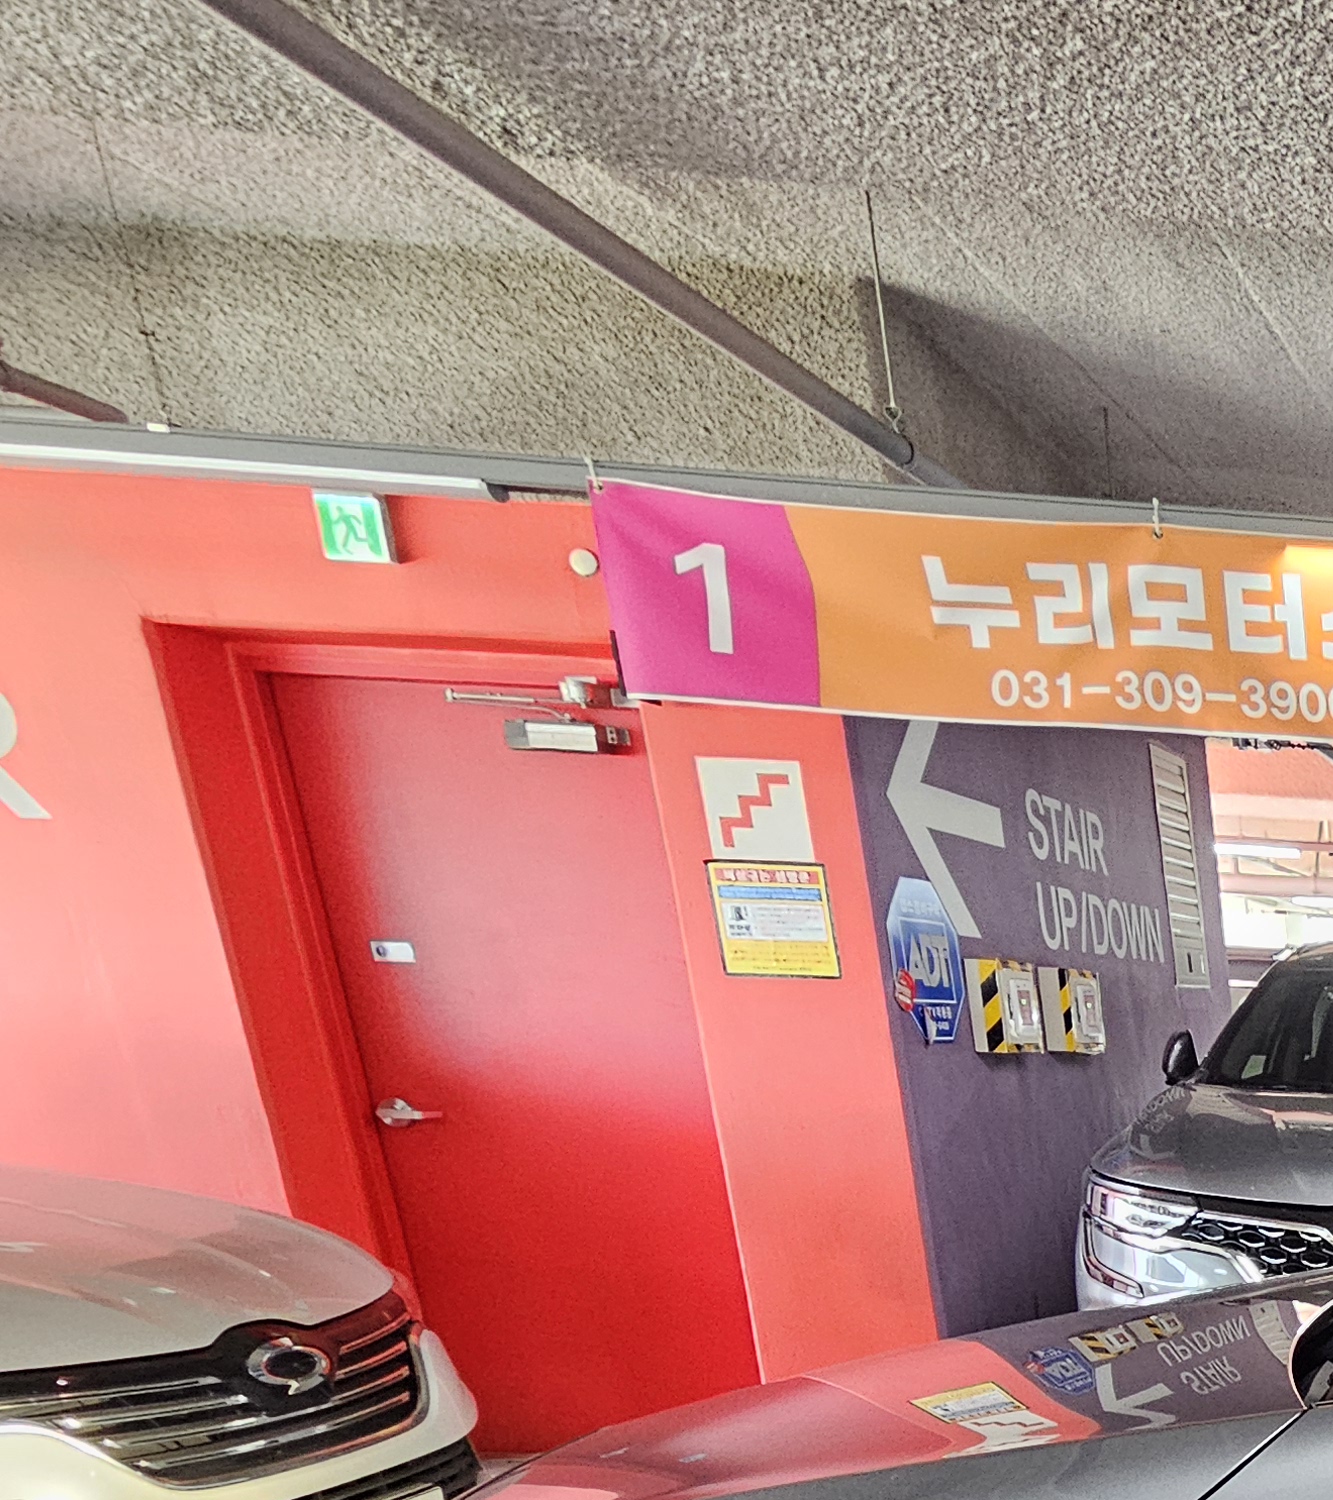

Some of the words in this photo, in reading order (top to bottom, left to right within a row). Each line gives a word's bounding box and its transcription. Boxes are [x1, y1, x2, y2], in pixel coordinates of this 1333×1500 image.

[674, 543, 734, 655] 1
[1024, 787, 1110, 877] STAIR
[908, 932, 951, 989] ADT
[1035, 881, 1165, 964] UP/DOWN
